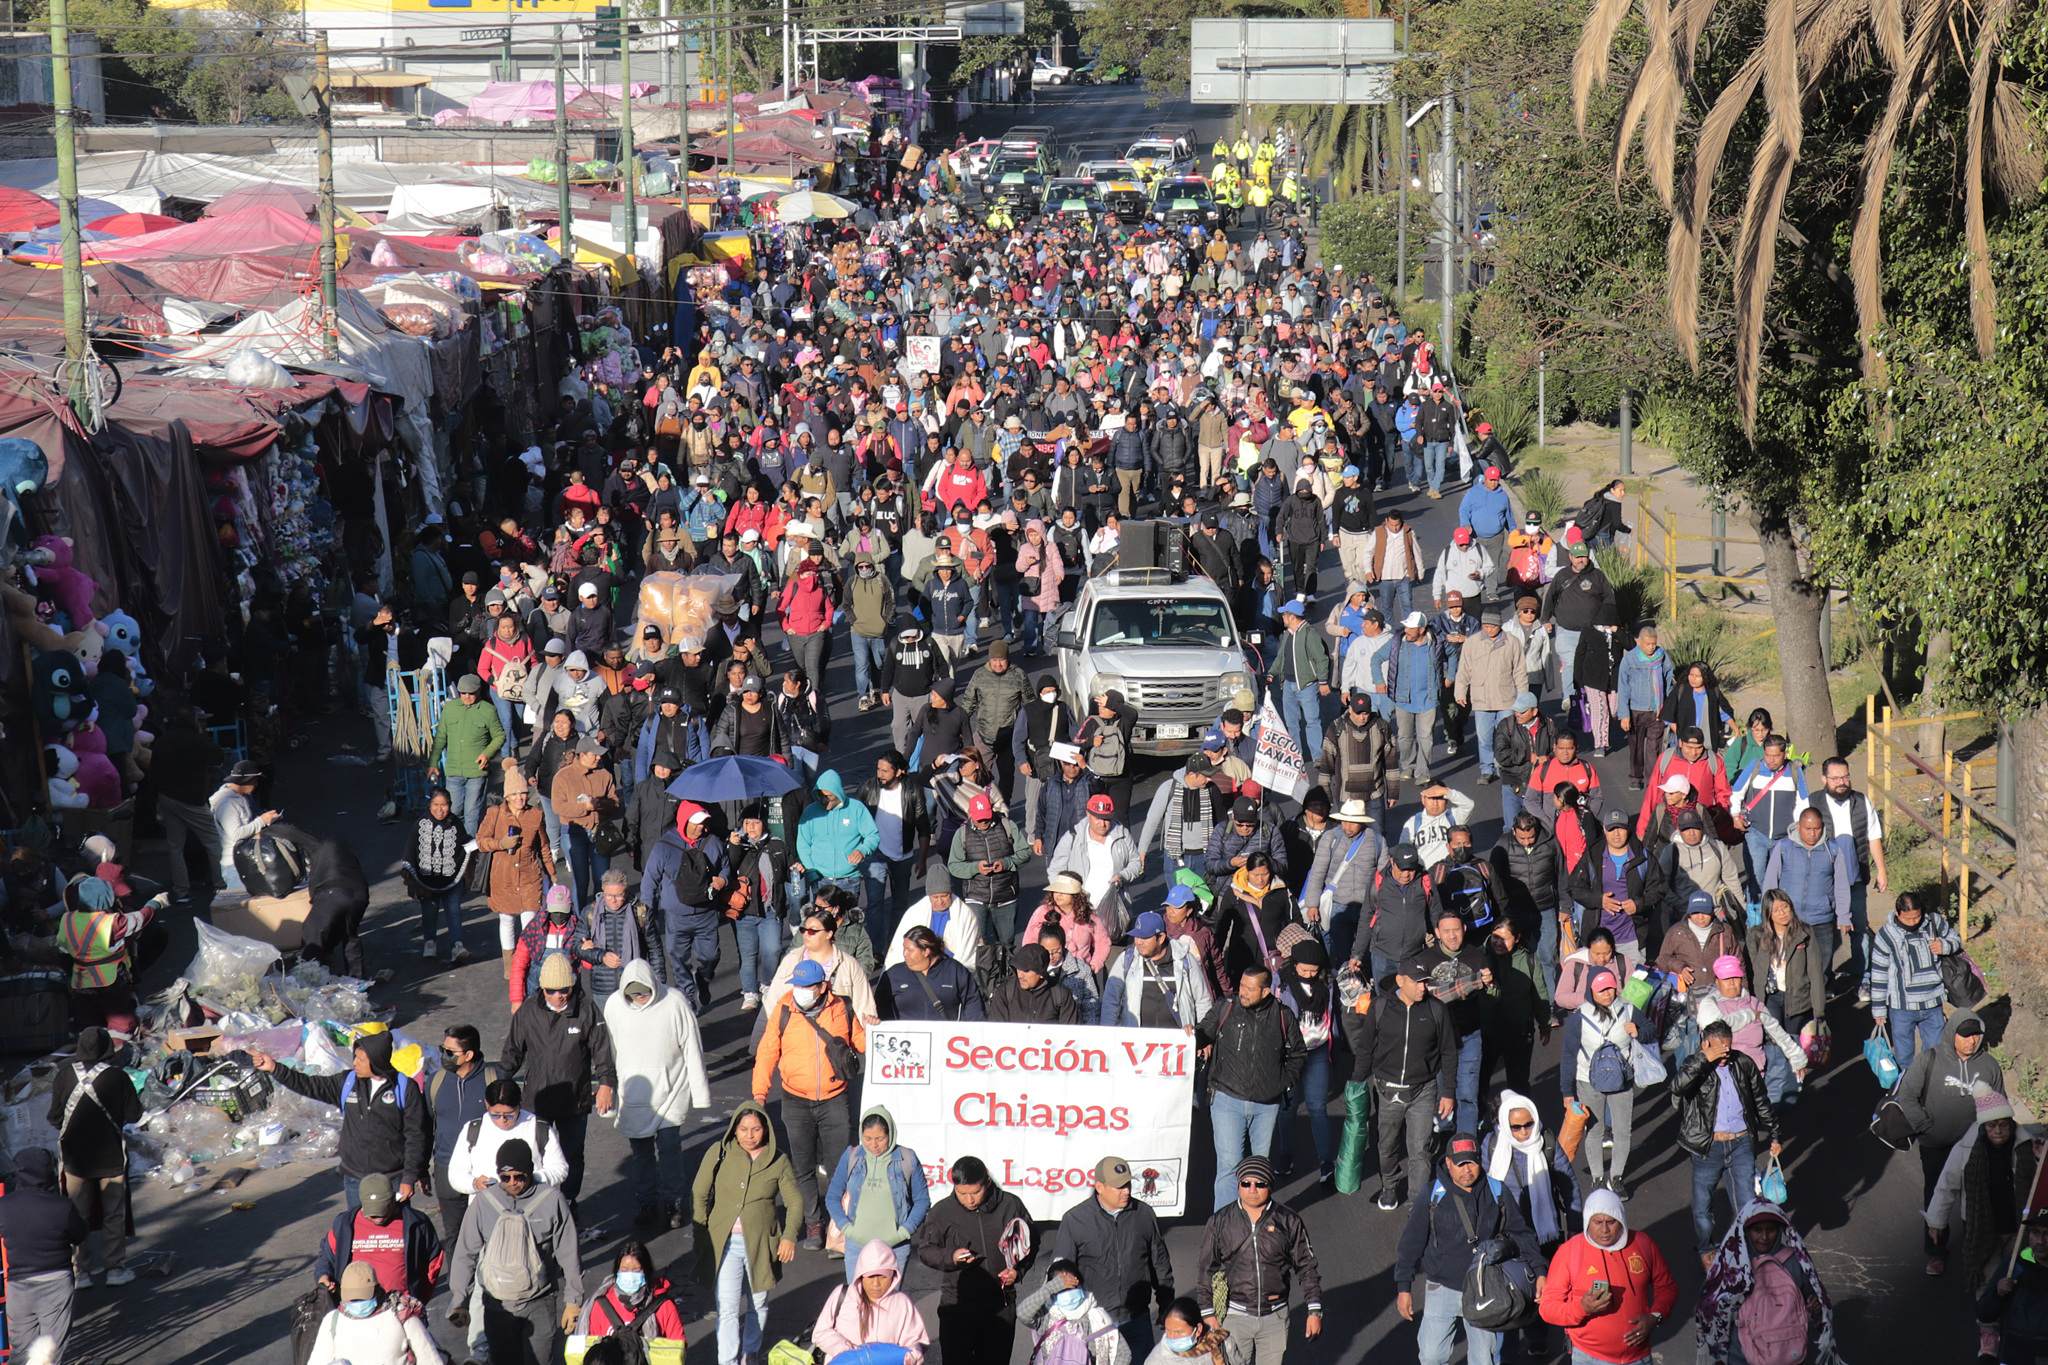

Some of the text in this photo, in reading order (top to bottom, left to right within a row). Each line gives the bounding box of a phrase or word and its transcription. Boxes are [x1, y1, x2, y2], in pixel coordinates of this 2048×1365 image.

[1256, 742, 1308, 775] LAXIACO
[881, 1064, 925, 1079] CNTE
[946, 1035, 1187, 1077] Sección VII
[954, 1092, 1129, 1136] Chiapas
